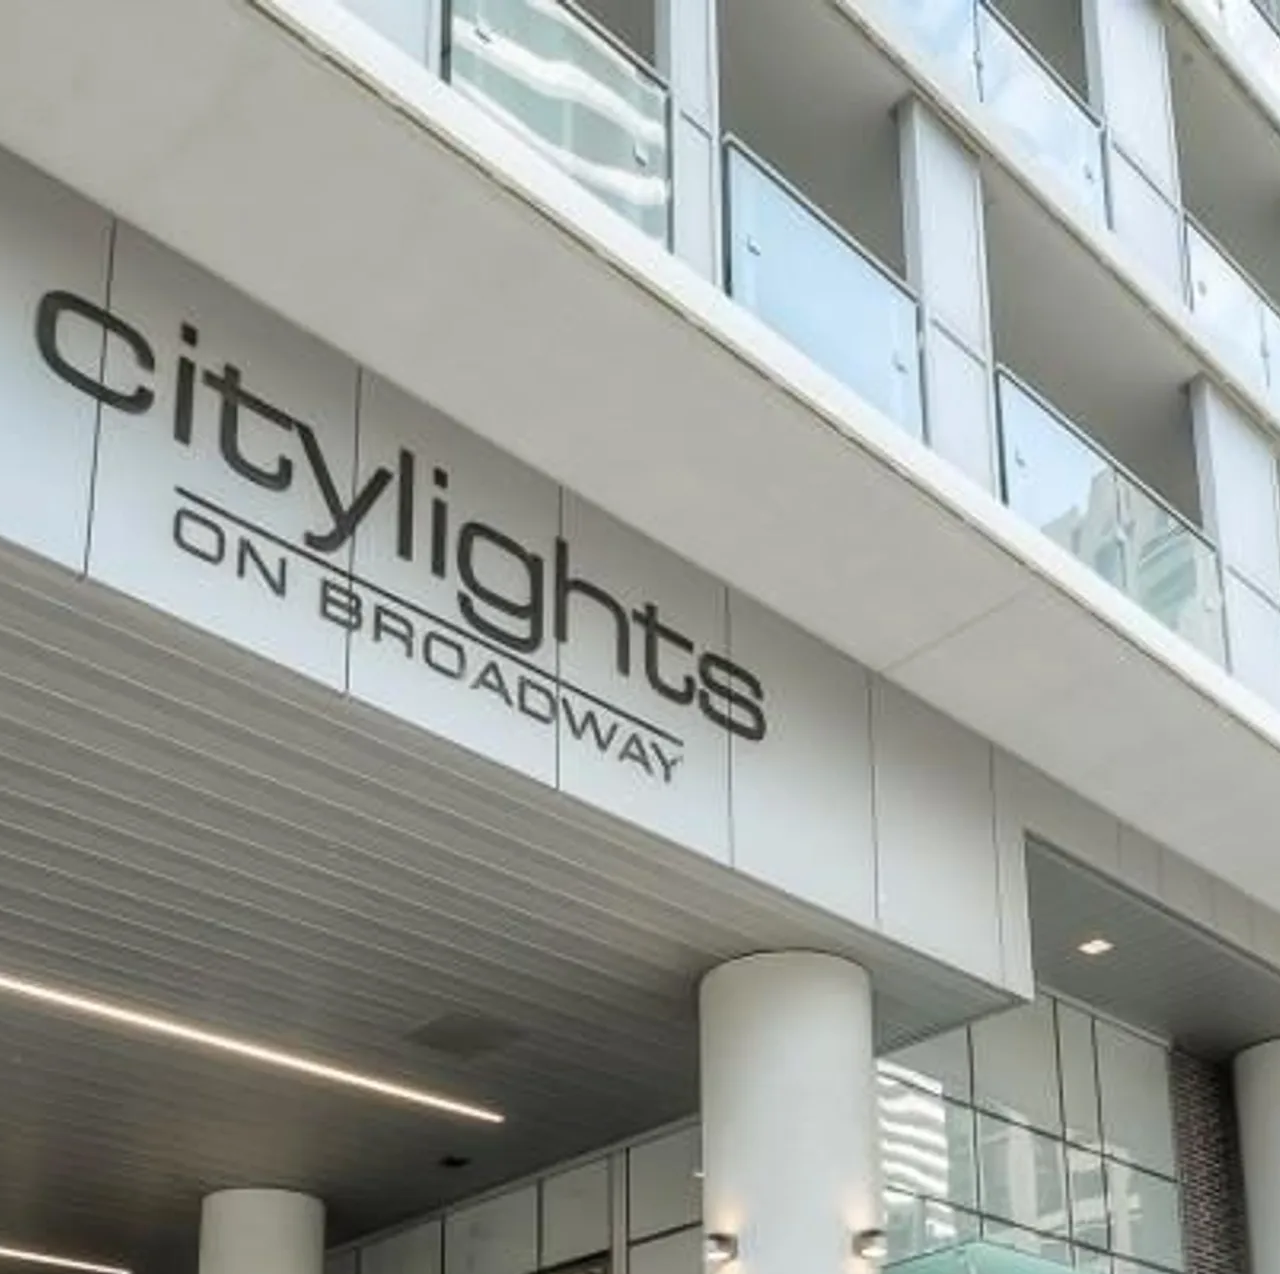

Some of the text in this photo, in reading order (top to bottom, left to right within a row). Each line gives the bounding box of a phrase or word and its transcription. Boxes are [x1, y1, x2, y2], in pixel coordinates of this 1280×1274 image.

[35, 290, 766, 742] citylights
[173, 508, 683, 783] ON BROADWAY
